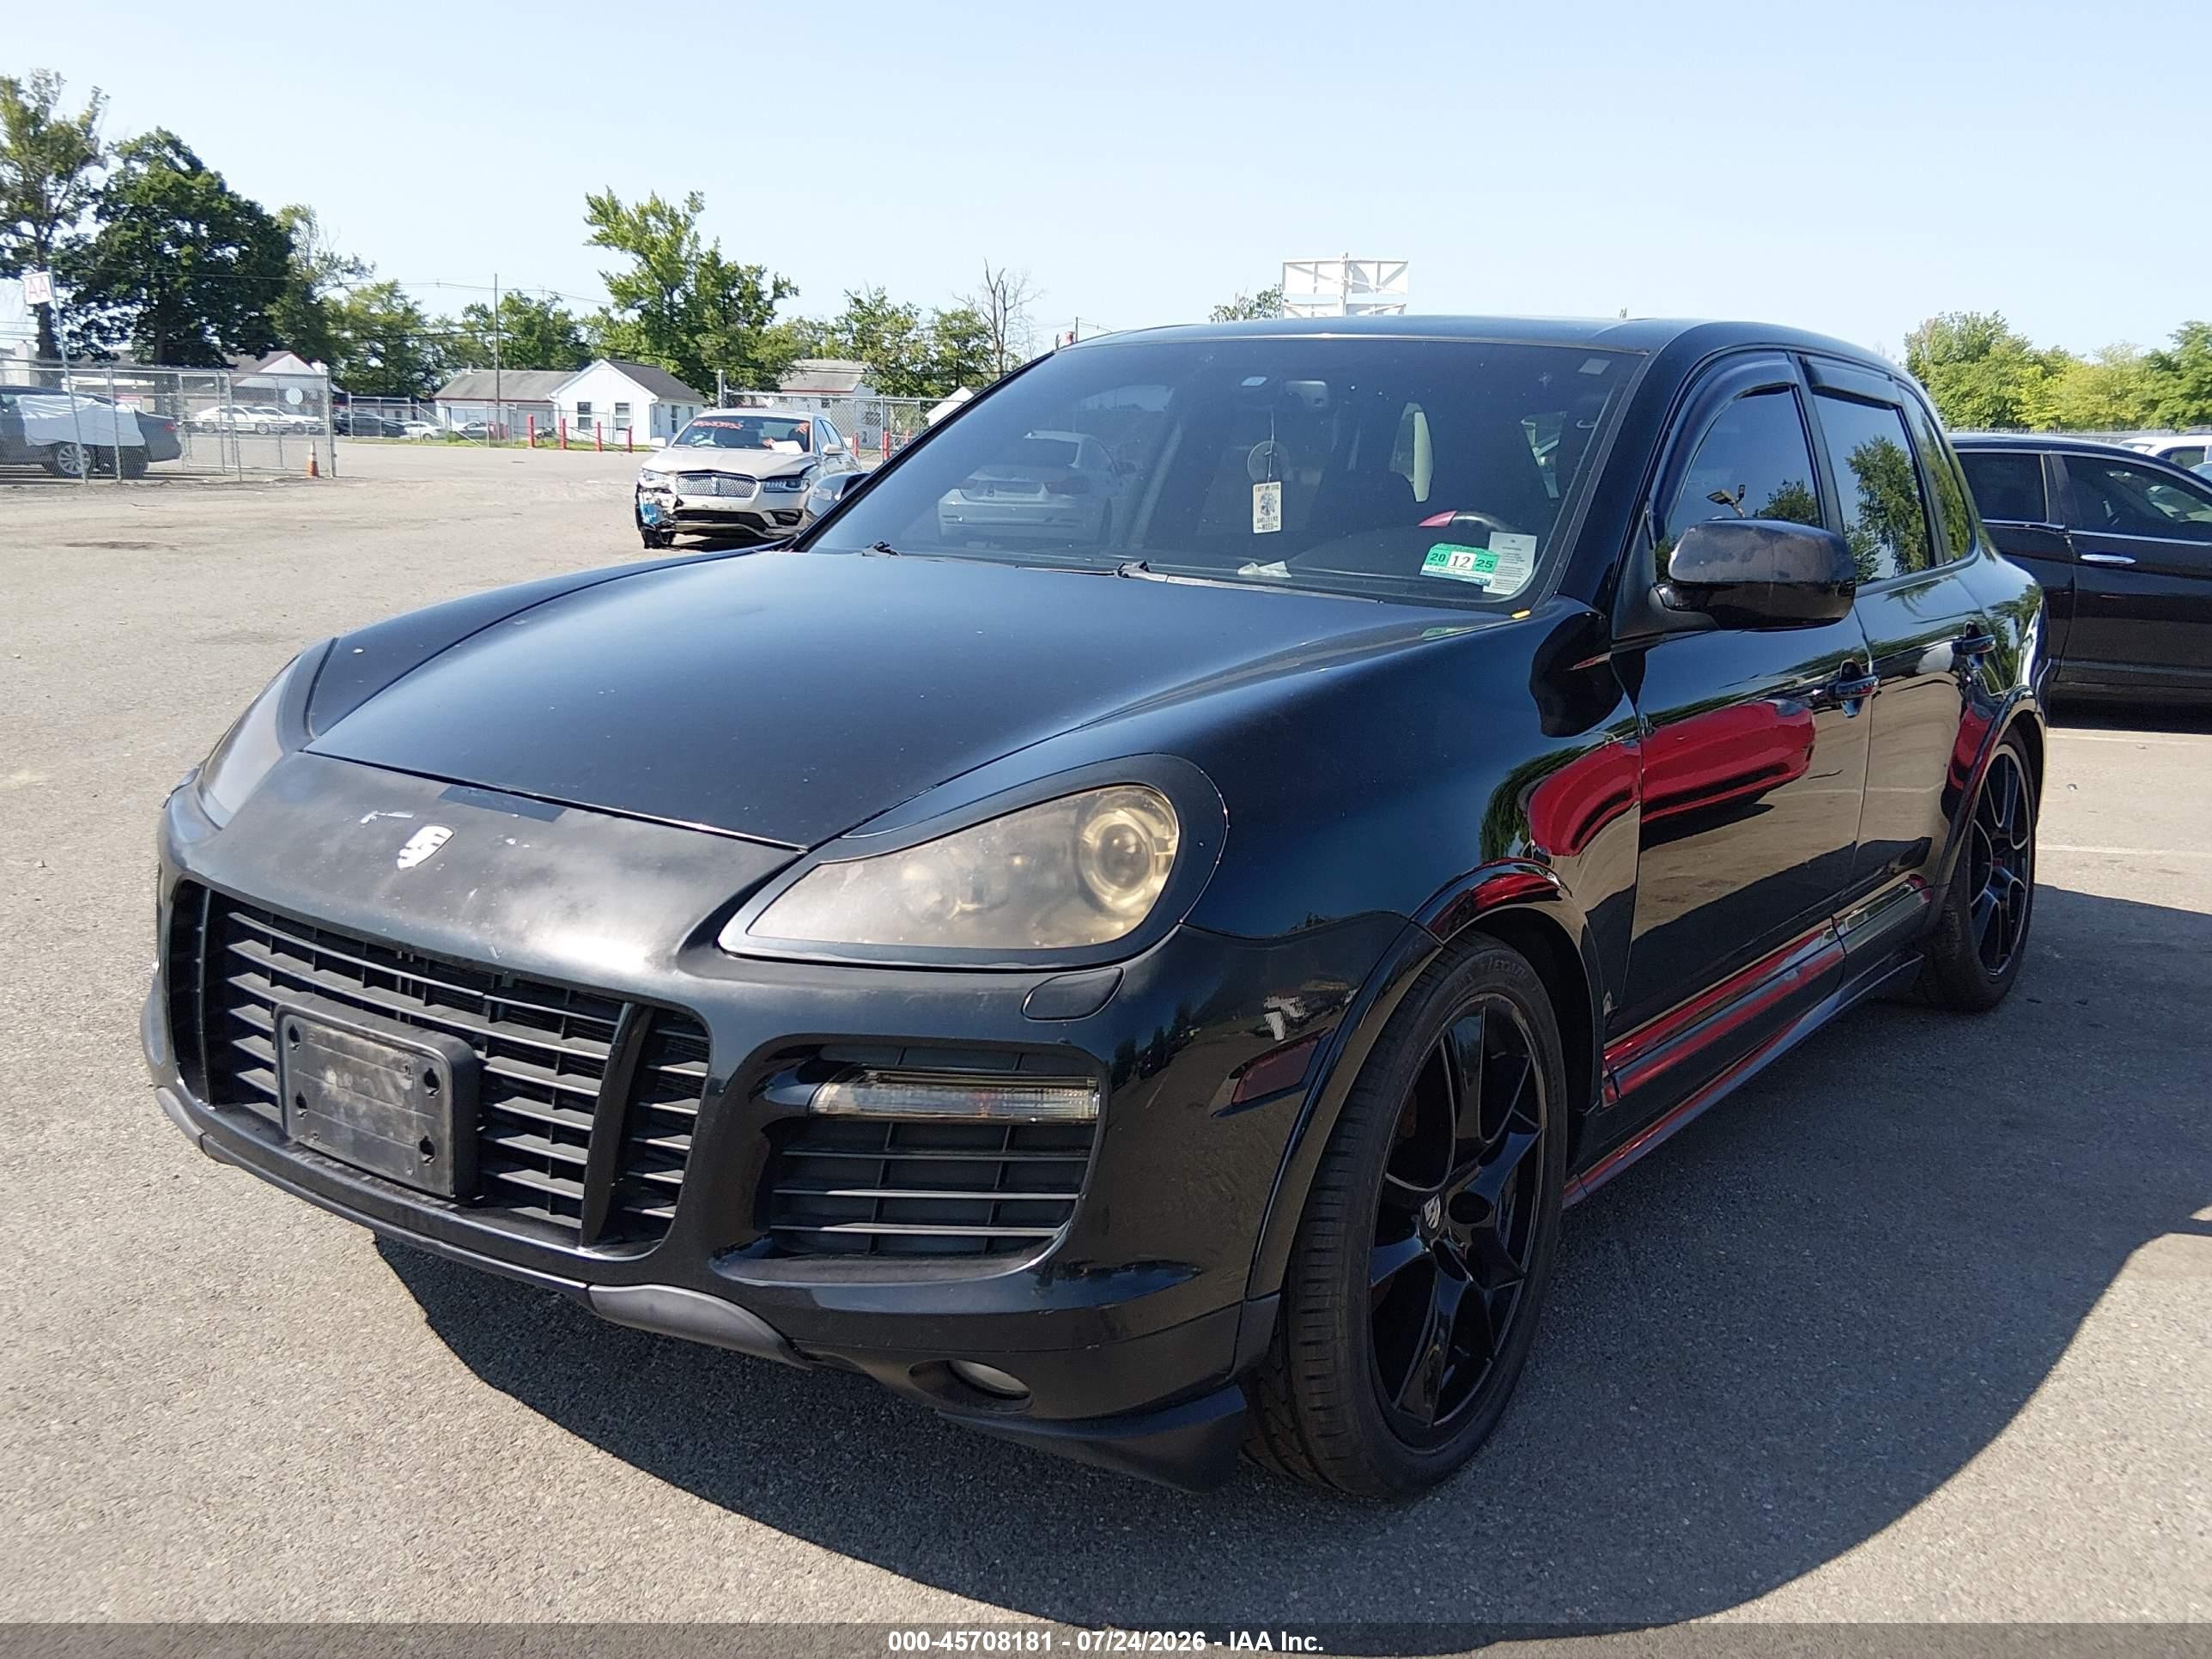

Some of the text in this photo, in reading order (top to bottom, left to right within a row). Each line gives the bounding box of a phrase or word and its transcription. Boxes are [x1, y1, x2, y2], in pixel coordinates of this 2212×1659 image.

[1430, 552, 1495, 568] 20 12 25
